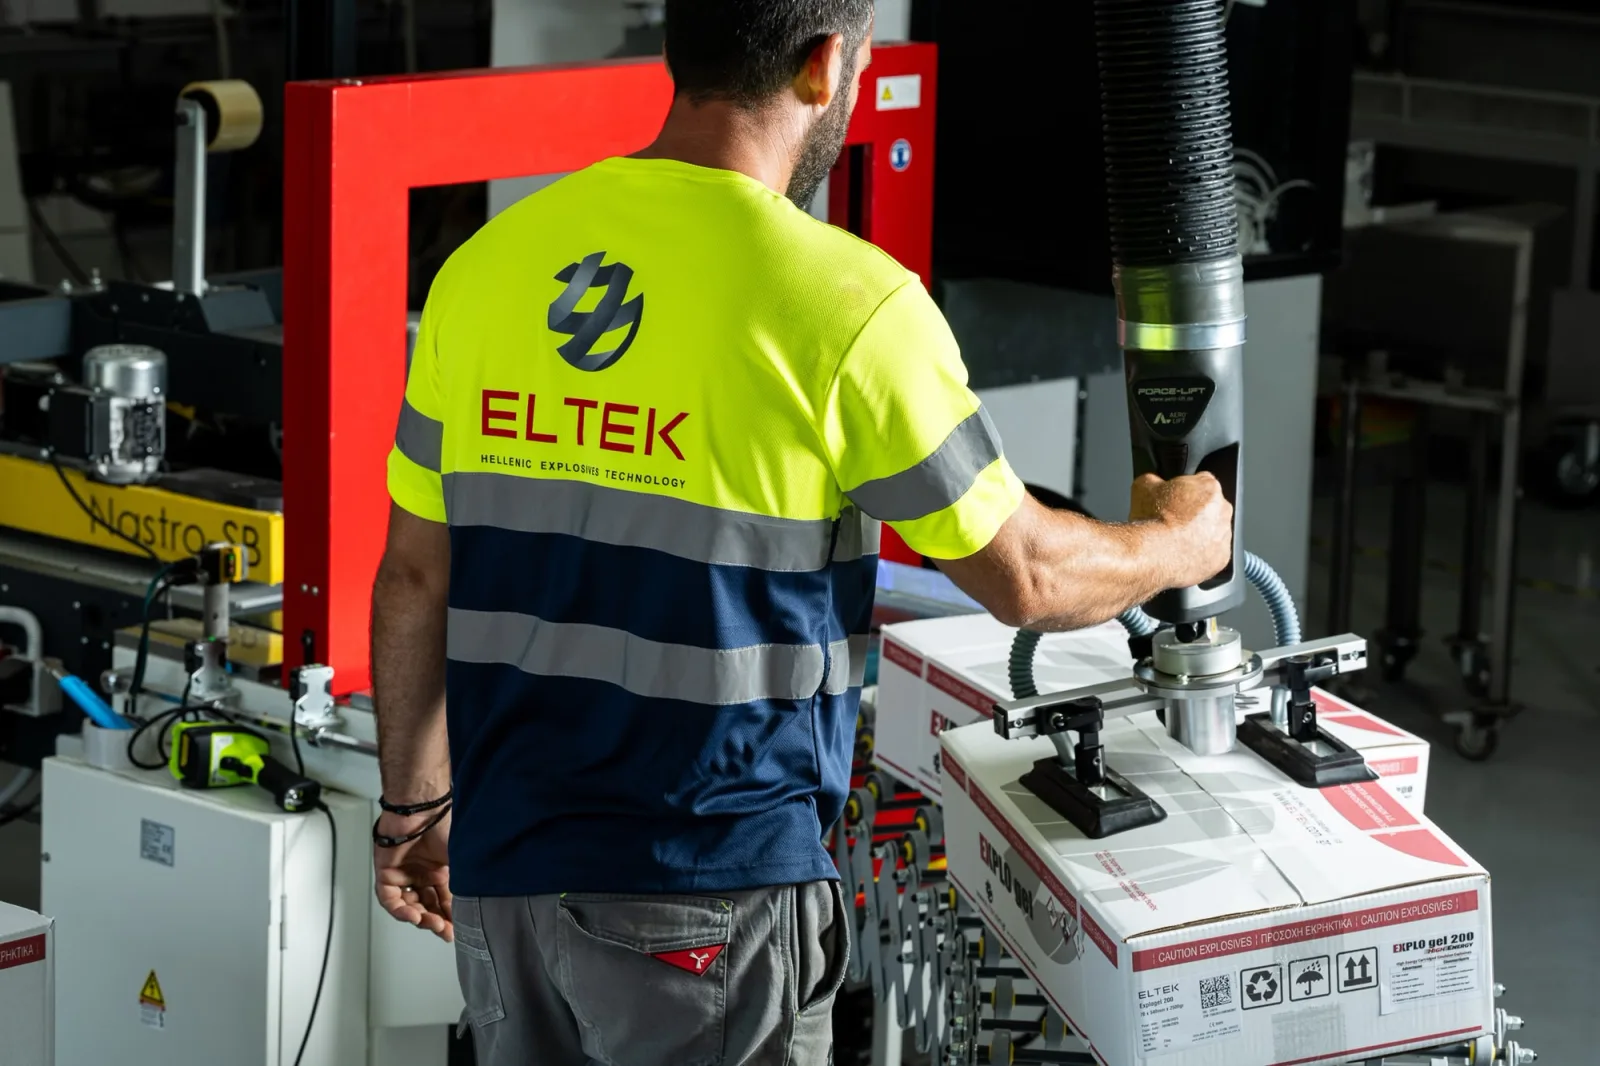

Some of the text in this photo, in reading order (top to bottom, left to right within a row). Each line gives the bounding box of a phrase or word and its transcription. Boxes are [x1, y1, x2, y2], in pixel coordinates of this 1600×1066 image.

[1137, 387, 1206, 395] FORCE-LIFT
[481, 389, 690, 461] ELTEK
[480, 454, 686, 489] HELLENIC EXPLOSIVES TECHNOLOGY
[1361, 899, 1453, 926] CAUTION EXPLOSIVES
[1261, 918, 1353, 943] ΠΡΟΣΟΧΗ ΕΚΡΗΚΤΙΚΑ
[1392, 931, 1474, 953] EXPLO gel 200
[1158, 936, 1252, 963] CAUTION EXPLOSIVES
[1447, 942, 1474, 951] ENERGY
[1138, 983, 1180, 999] ELTEK
[1163, 996, 1174, 1004] 200
